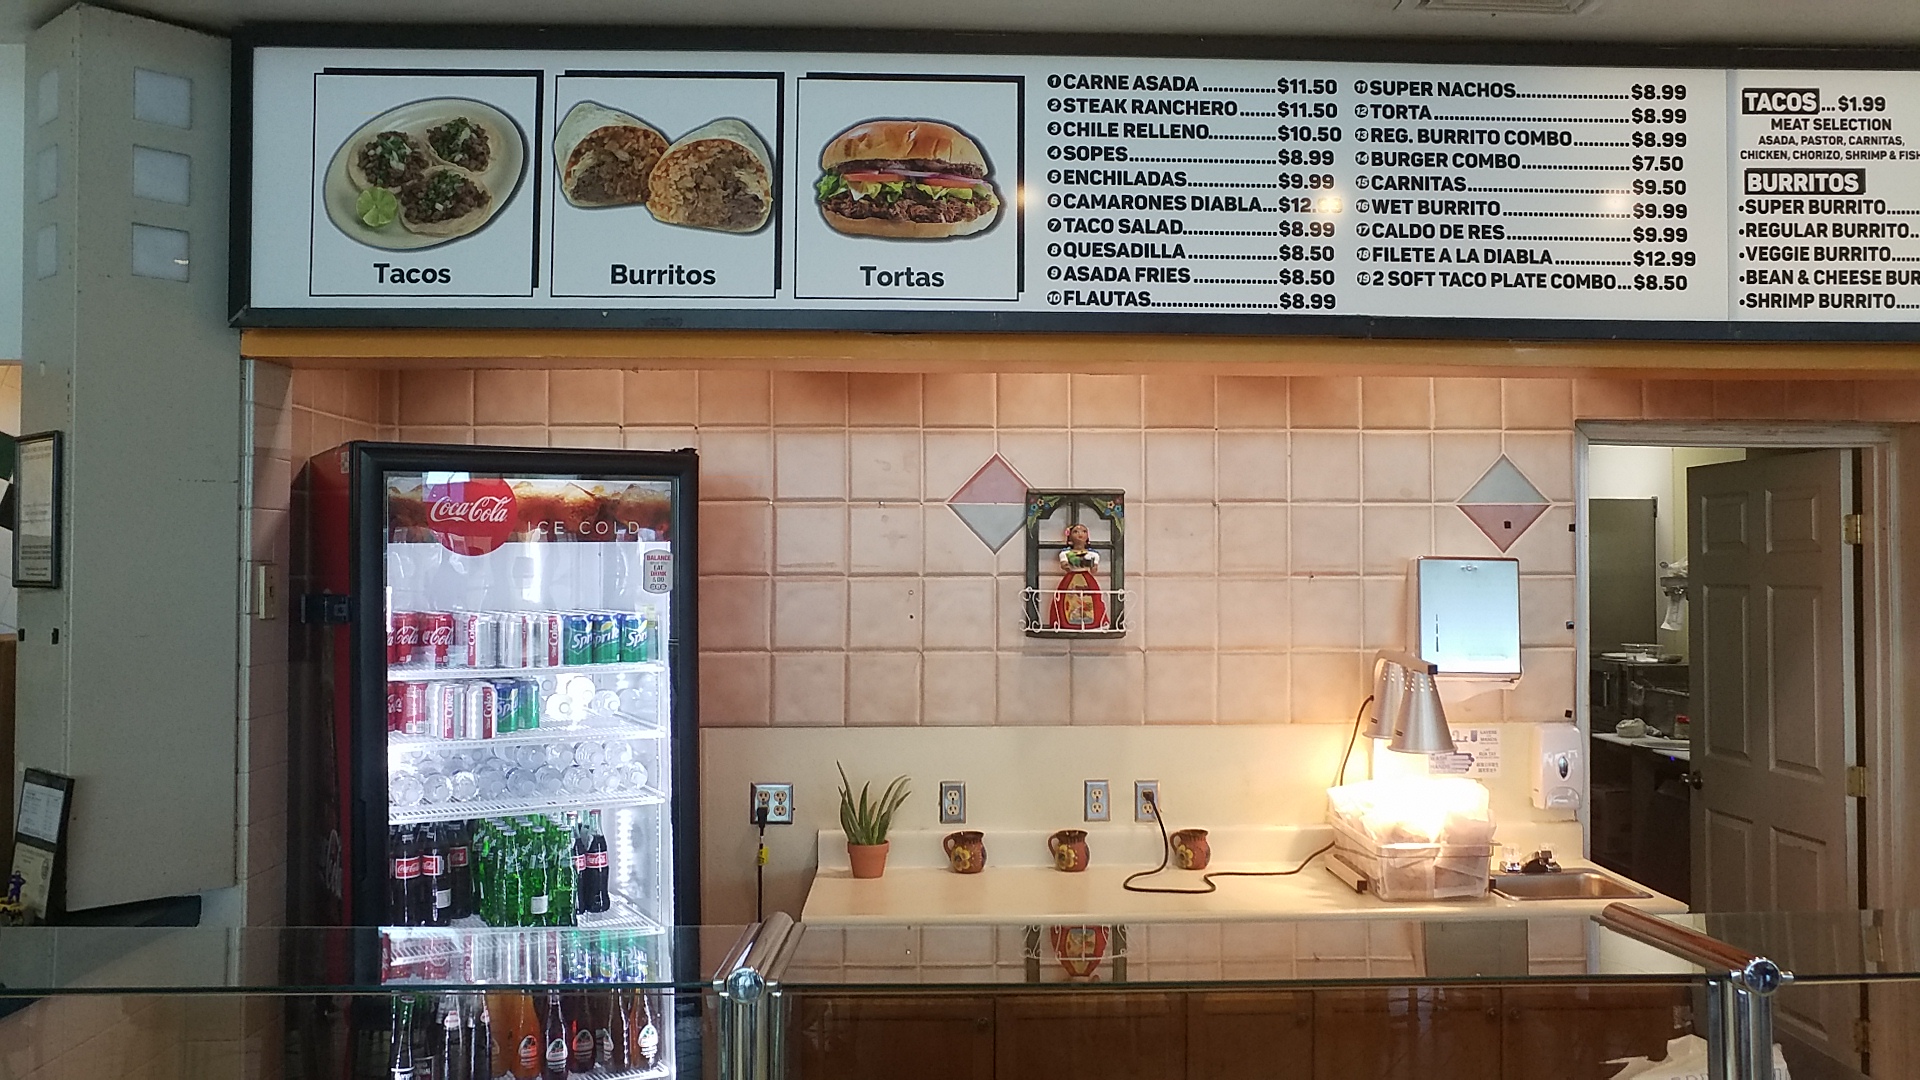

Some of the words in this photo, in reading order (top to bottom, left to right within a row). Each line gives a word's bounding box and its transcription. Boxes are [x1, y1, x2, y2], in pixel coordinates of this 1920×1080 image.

[1063, 74, 1129, 90] CARNE
[1132, 76, 1199, 92] ASADA
[1277, 78, 1337, 95] $11.50
[1370, 81, 1433, 96] SUPER
[1437, 82, 1516, 98] NACHOS
[1631, 84, 1686, 101] $8.99
[1063, 98, 1127, 114] STEAK
[1131, 100, 1237, 116] RANCHERO
[1277, 102, 1338, 118] $11.50
[1744, 92, 1817, 111] TACOS
[1838, 95, 1886, 112] $1.99
[1370, 104, 1432, 120] TORTA
[1631, 108, 1687, 124] $8.99
[1063, 122, 1118, 138] CHILE
[1123, 123, 1209, 139] RELLENO
[1277, 125, 1342, 142] $10.50
[1771, 118, 1810, 130] MEAT
[1813, 118, 1892, 131] SELECTION
[1371, 128, 1413, 144] REG.
[1418, 130, 1500, 145] BURRITO
[1504, 131, 1571, 146] COMBO
[1631, 132, 1687, 148] $8.99
[1758, 136, 1799, 147] ASADA,
[1800, 136, 1846, 147] PASTOR,
[1849, 136, 1905, 147] CARNITAS,
[1063, 146, 1128, 162] SOPES
[1278, 149, 1334, 165] $8.99
[1371, 152, 1448, 168] BURGER
[1452, 153, 1520, 169] COMBO
[1632, 155, 1683, 172] $7.50
[1740, 150, 1790, 161] CHICKEN,
[1792, 150, 1843, 161] CHORIZO,
[1845, 150, 1887, 160] SHRIMP
[1890, 151, 1897, 160] &
[1064, 170, 1187, 187] ENCHILADAS
[1278, 172, 1334, 189] $9.99
[1371, 176, 1466, 192] CARNITAS
[1632, 179, 1686, 196] $9.50
[1748, 173, 1859, 192] BURRITOS
[1063, 193, 1187, 210] CAMARONES
[1191, 196, 1262, 212] DIABLA
[1279, 196, 1342, 213] $12.
[1372, 199, 1413, 215] WET
[1418, 200, 1501, 216] BURRITO
[1633, 203, 1687, 219] $9.99
[1745, 200, 1804, 215] SUPER
[1809, 200, 1885, 215] BURRITO
[1063, 217, 1114, 233] TACO
[1118, 218, 1183, 235] SALAD
[1279, 220, 1335, 237] $8.99
[1372, 223, 1436, 240] CALDO
[1440, 225, 1464, 240] DE
[1468, 225, 1504, 240] RES
[1633, 226, 1688, 243] $9.99
[1745, 223, 1828, 238] REGULAR
[1832, 223, 1909, 238] BURRITO
[1063, 241, 1186, 259] QUESADILLA
[1279, 244, 1335, 261] $8.50
[1372, 247, 1436, 263] FILETE
[1439, 248, 1452, 264] A
[1456, 249, 1479, 264] LA
[1484, 249, 1552, 265] DIABLA
[1633, 250, 1696, 267] $12.99
[1746, 246, 1810, 261] VEGGIE
[1814, 246, 1891, 262] BURRITO
[373, 262, 451, 285] Tacos
[610, 264, 716, 287] Burritos
[859, 265, 945, 288] Tortas
[1064, 266, 1131, 282] ASADA
[1135, 267, 1191, 283] FRIES
[1279, 268, 1335, 285] $8.50
[1372, 271, 1384, 286] 2
[1388, 271, 1436, 288] SOFT
[1439, 272, 1487, 288] TACO
[1491, 273, 1547, 289] PLATE
[1550, 274, 1616, 290] COMBO
[1633, 274, 1687, 291] $8.50
[1746, 270, 1793, 285] BEAN
[1797, 270, 1809, 285] &
[1813, 270, 1882, 285] CHEESE
[1064, 290, 1151, 306] FLAUTAS
[1279, 292, 1336, 309] $8.99
[1746, 293, 1815, 309] SHRIMP
[1819, 293, 1896, 309] BURRITO
[527, 521, 565, 535] ICE
[579, 521, 640, 535] COLD
